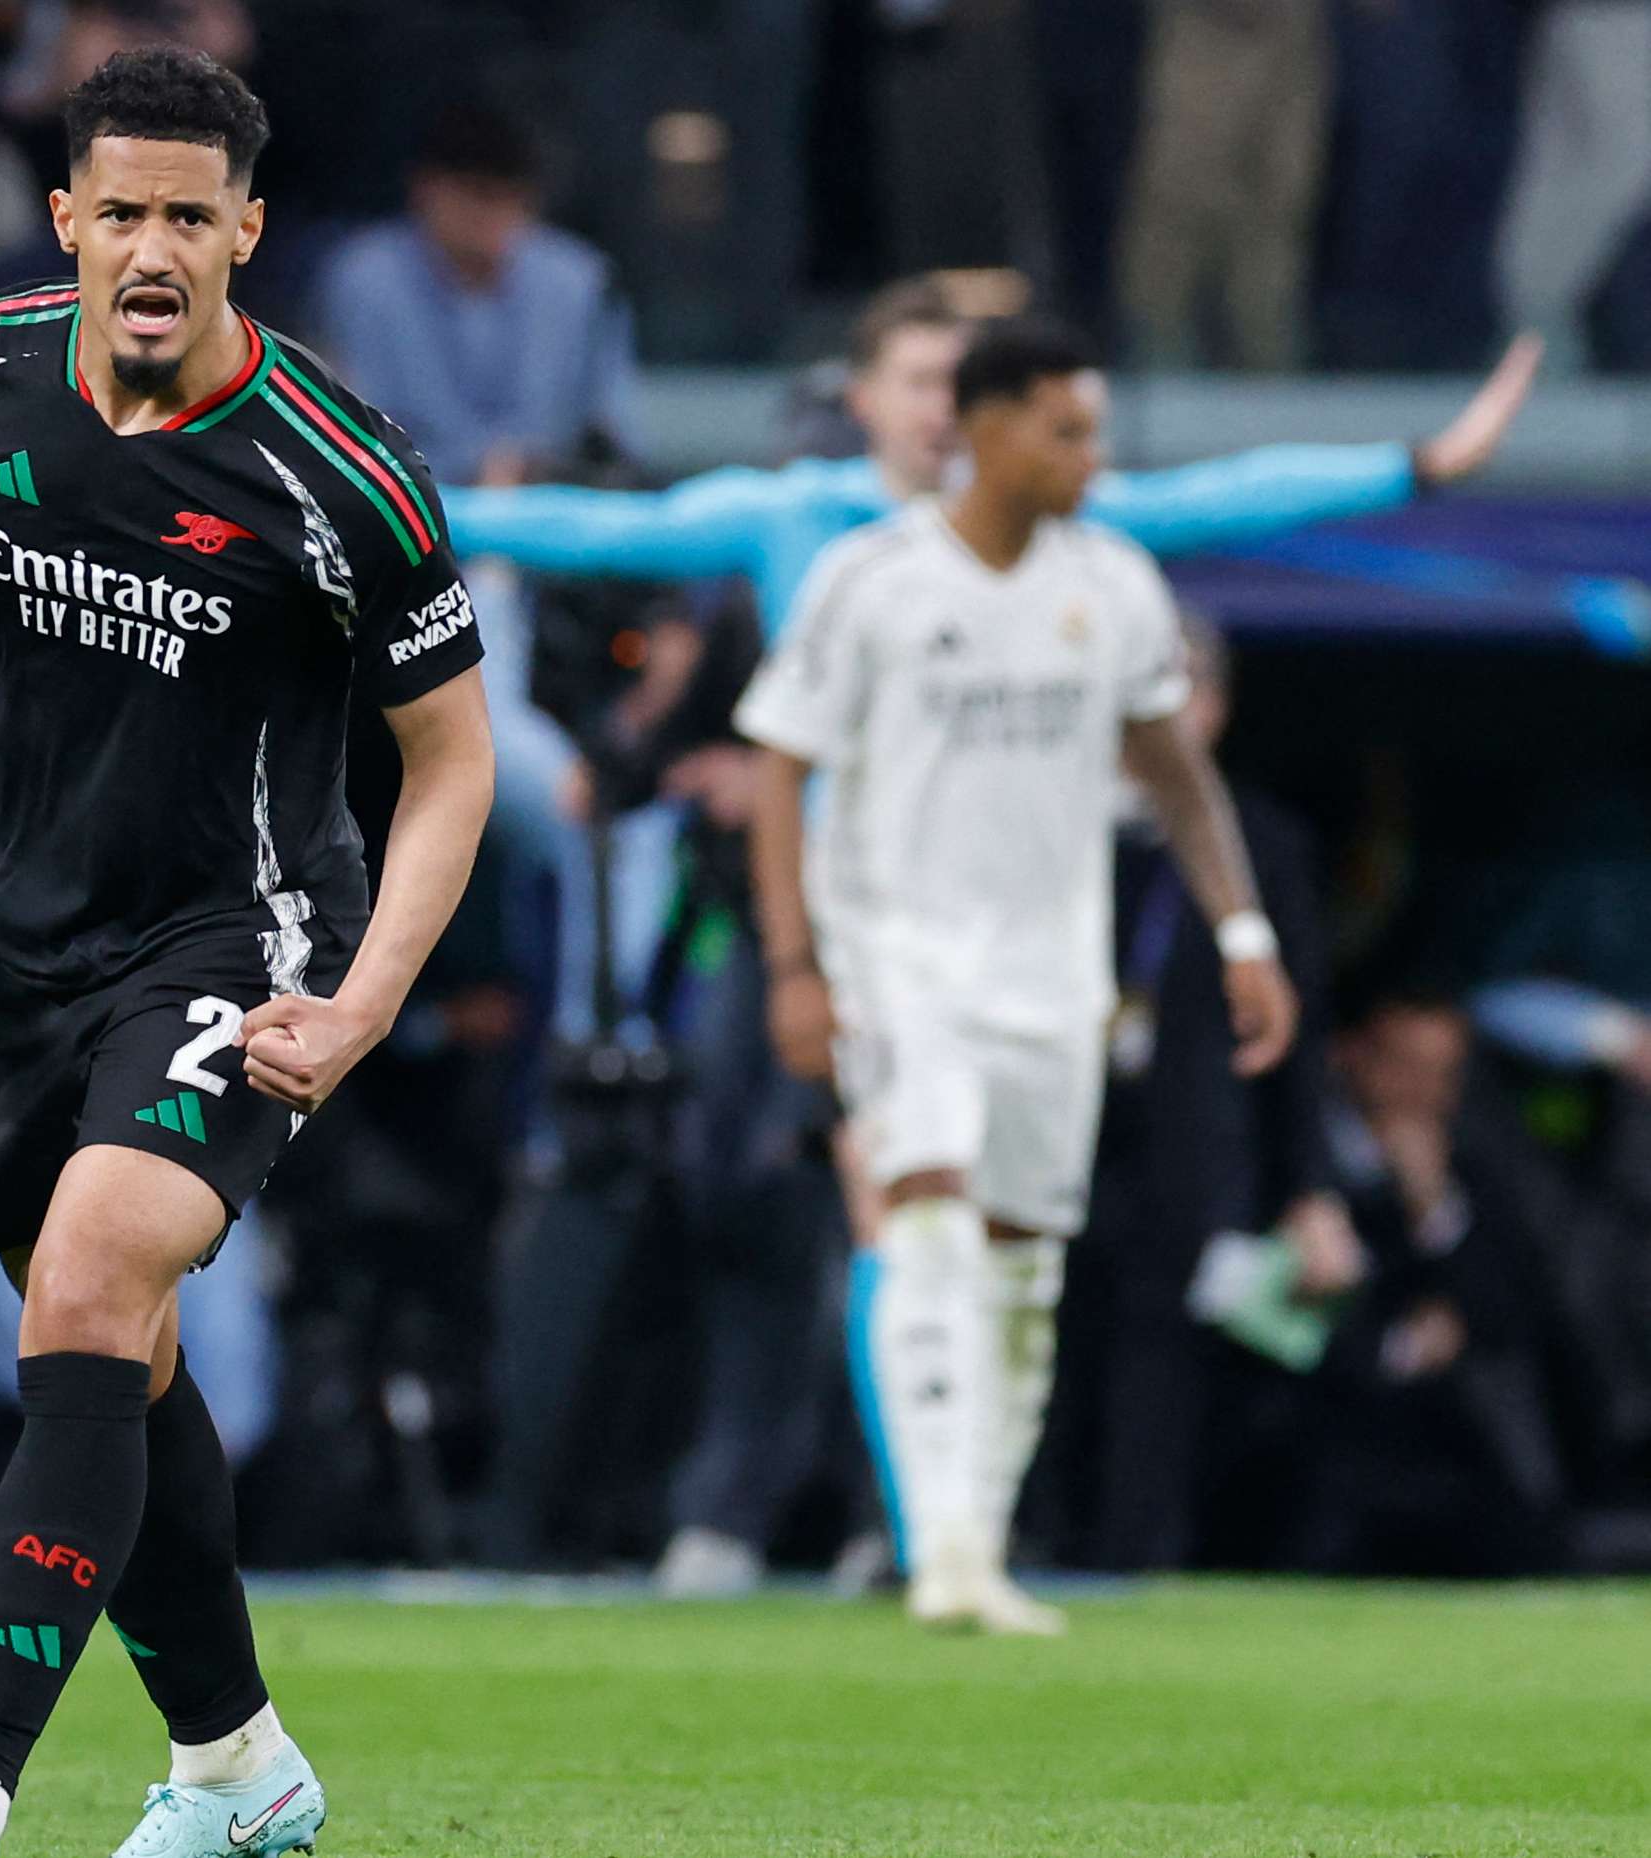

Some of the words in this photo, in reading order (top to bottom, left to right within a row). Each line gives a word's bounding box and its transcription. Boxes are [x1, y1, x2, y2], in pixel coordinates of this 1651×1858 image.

[19, 593, 67, 638] FLY
[79, 608, 186, 679] BETTER
[165, 994, 245, 1098] 2
[13, 1534, 98, 1588] AFC
